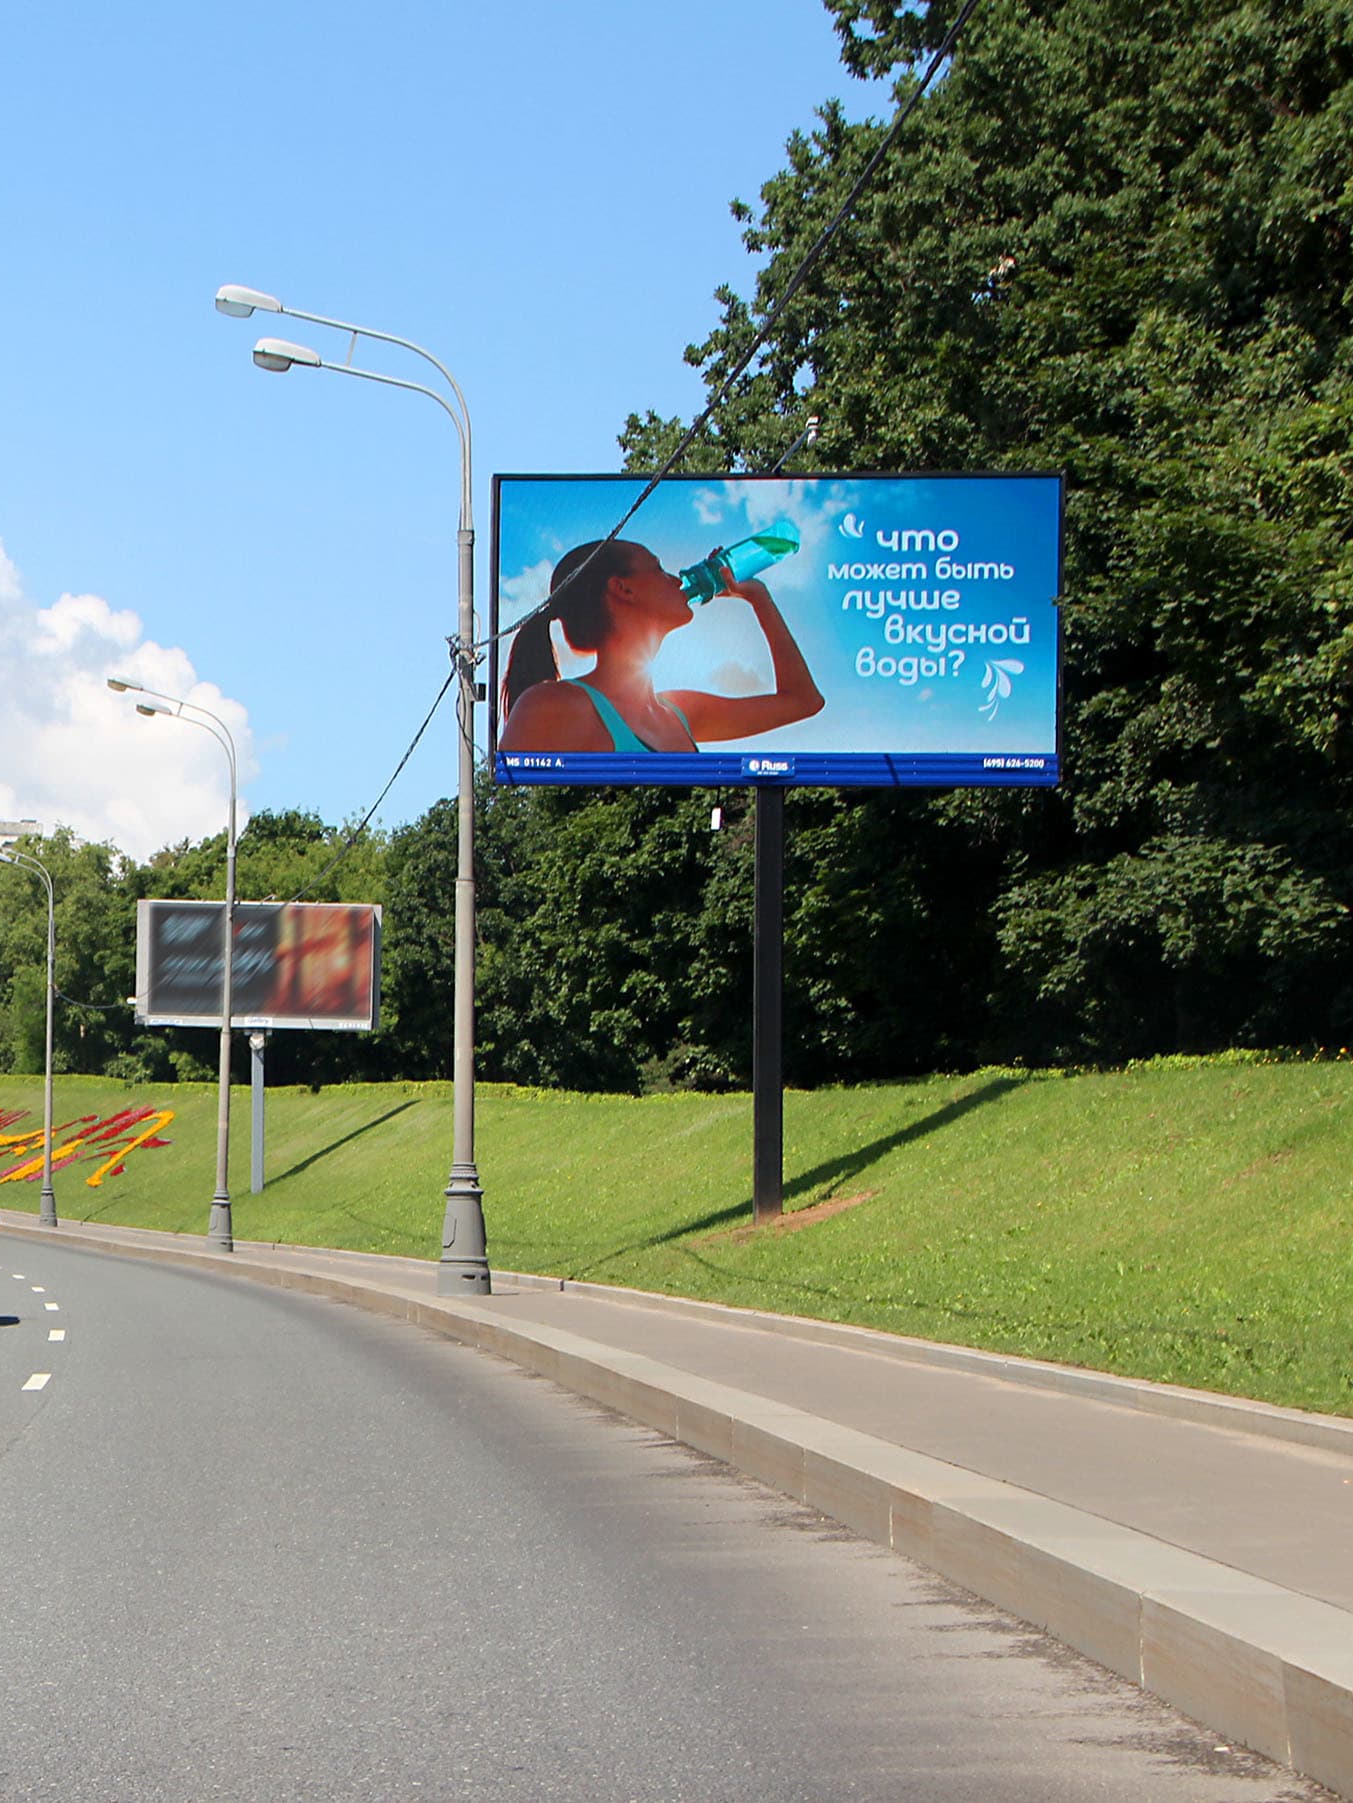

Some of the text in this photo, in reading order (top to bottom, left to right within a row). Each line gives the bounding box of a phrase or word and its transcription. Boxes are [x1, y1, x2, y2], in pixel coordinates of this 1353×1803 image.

[876, 529, 960, 552] что
[827, 556, 1015, 580] может быть
[841, 589, 961, 619] лучше
[883, 613, 1031, 653] вкусной
[854, 646, 966, 685] воды?
[761, 760, 788, 771] Russ
